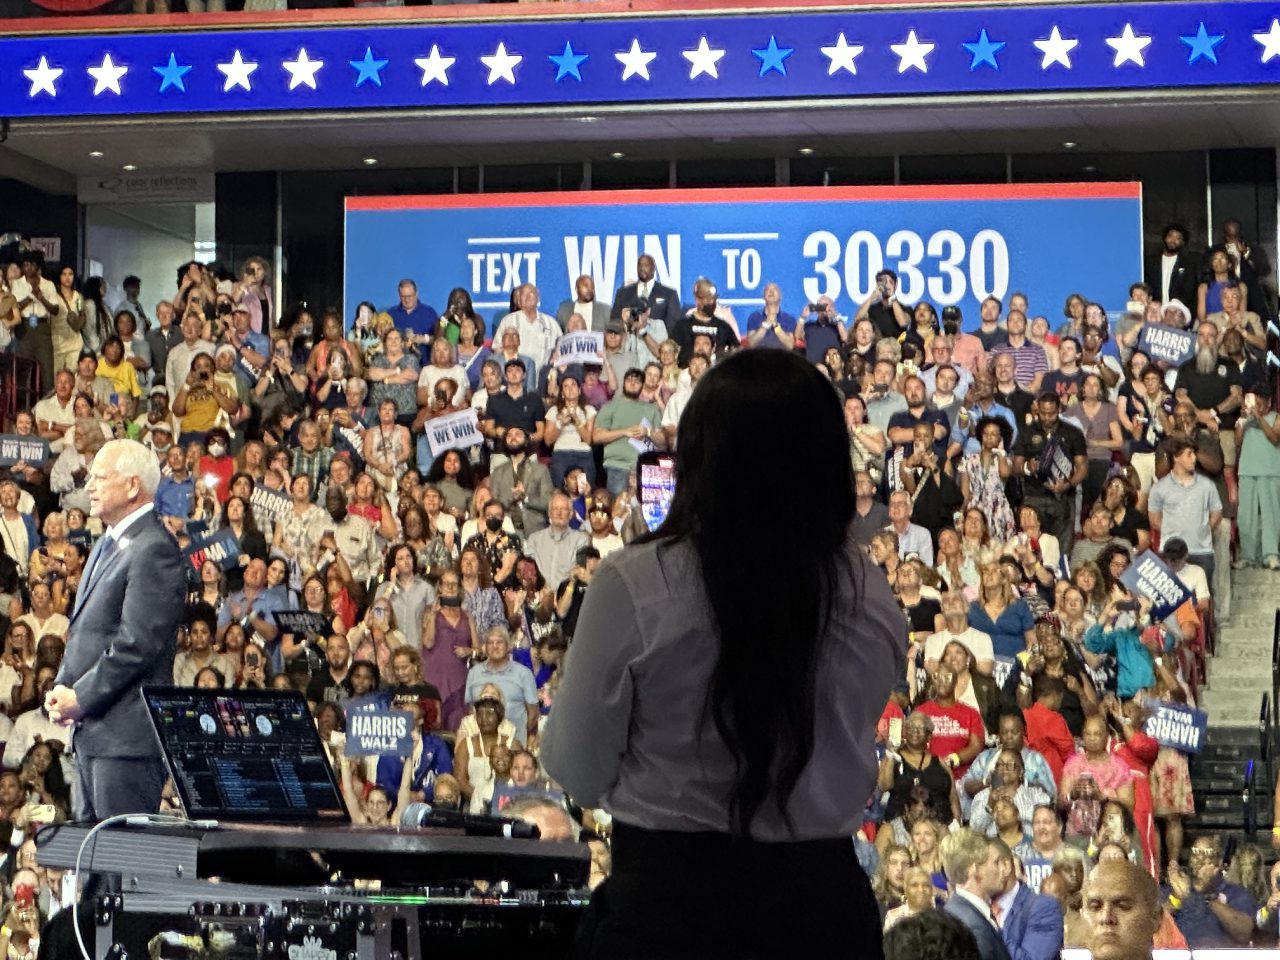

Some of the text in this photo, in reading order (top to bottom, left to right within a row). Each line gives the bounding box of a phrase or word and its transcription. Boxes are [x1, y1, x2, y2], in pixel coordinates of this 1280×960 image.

[468, 229, 1010, 308] TEXT WIN TO 30330
[560, 340, 597, 356] WE WIN
[1145, 327, 1191, 355] HARRIS
[1151, 344, 1180, 362] WALZ
[433, 422, 475, 445] WE WIN
[2, 445, 43, 460] WE WIN
[1135, 578, 1168, 608] WALZ
[1136, 558, 1184, 606] HARRIS
[351, 714, 407, 738] HARRIS
[1158, 706, 1194, 724] WALZ
[360, 736, 398, 750] WALZ
[1146, 715, 1199, 748] HARRIS
